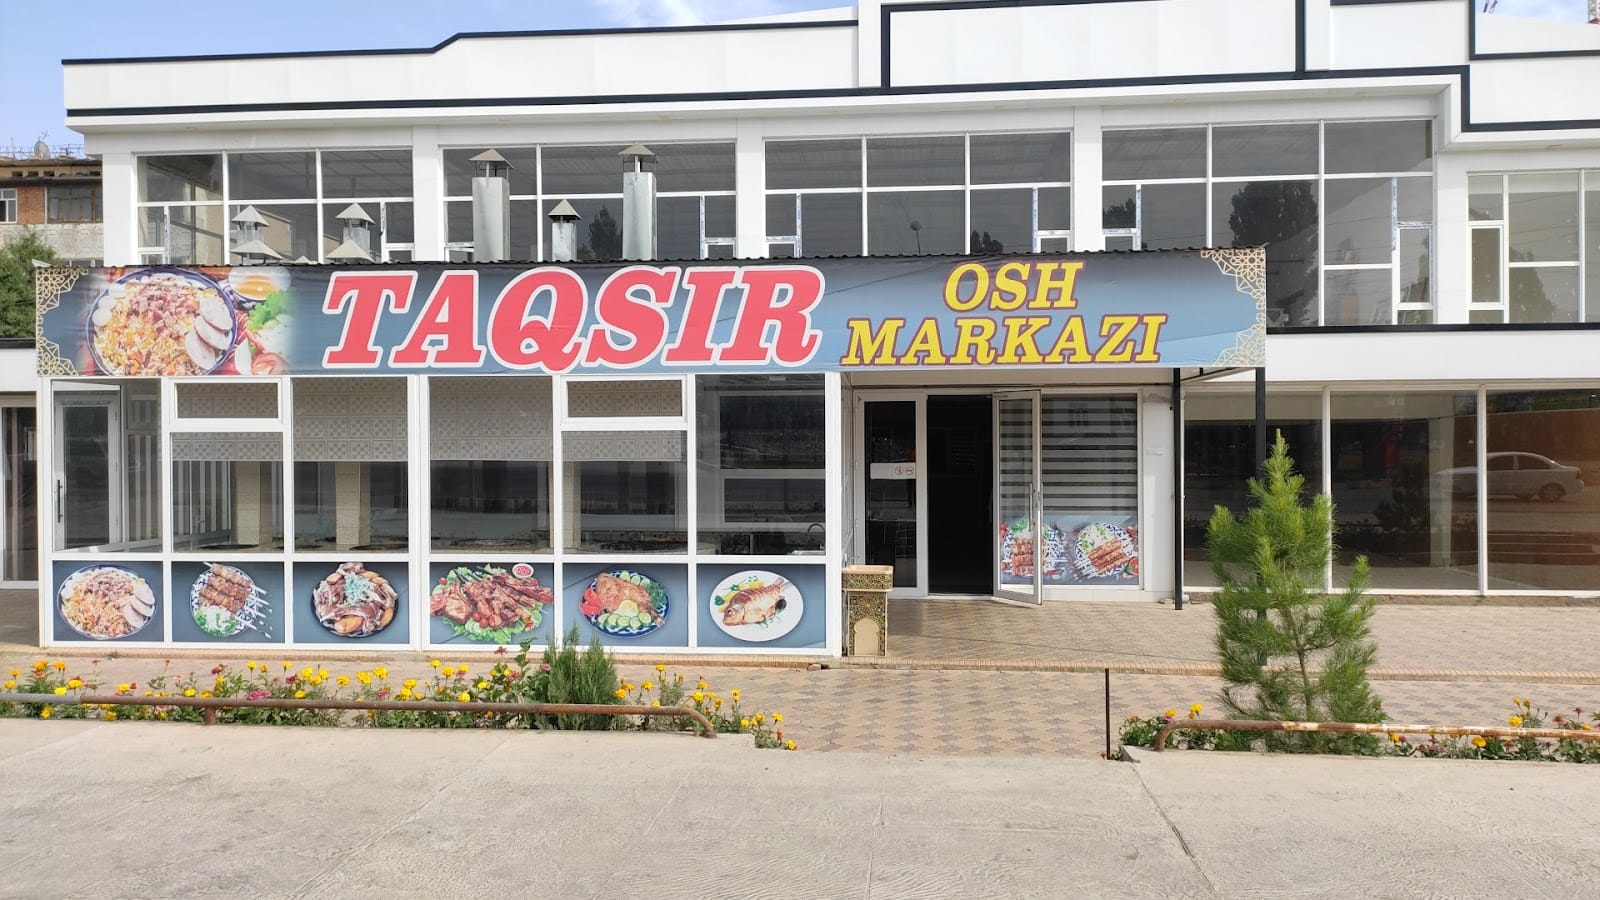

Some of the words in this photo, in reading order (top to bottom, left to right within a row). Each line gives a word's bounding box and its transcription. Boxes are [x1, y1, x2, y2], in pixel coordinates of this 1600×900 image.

[943, 260, 1085, 312] OSH
[322, 265, 825, 373] TAQSIR
[840, 313, 1167, 366] MARKAZI
